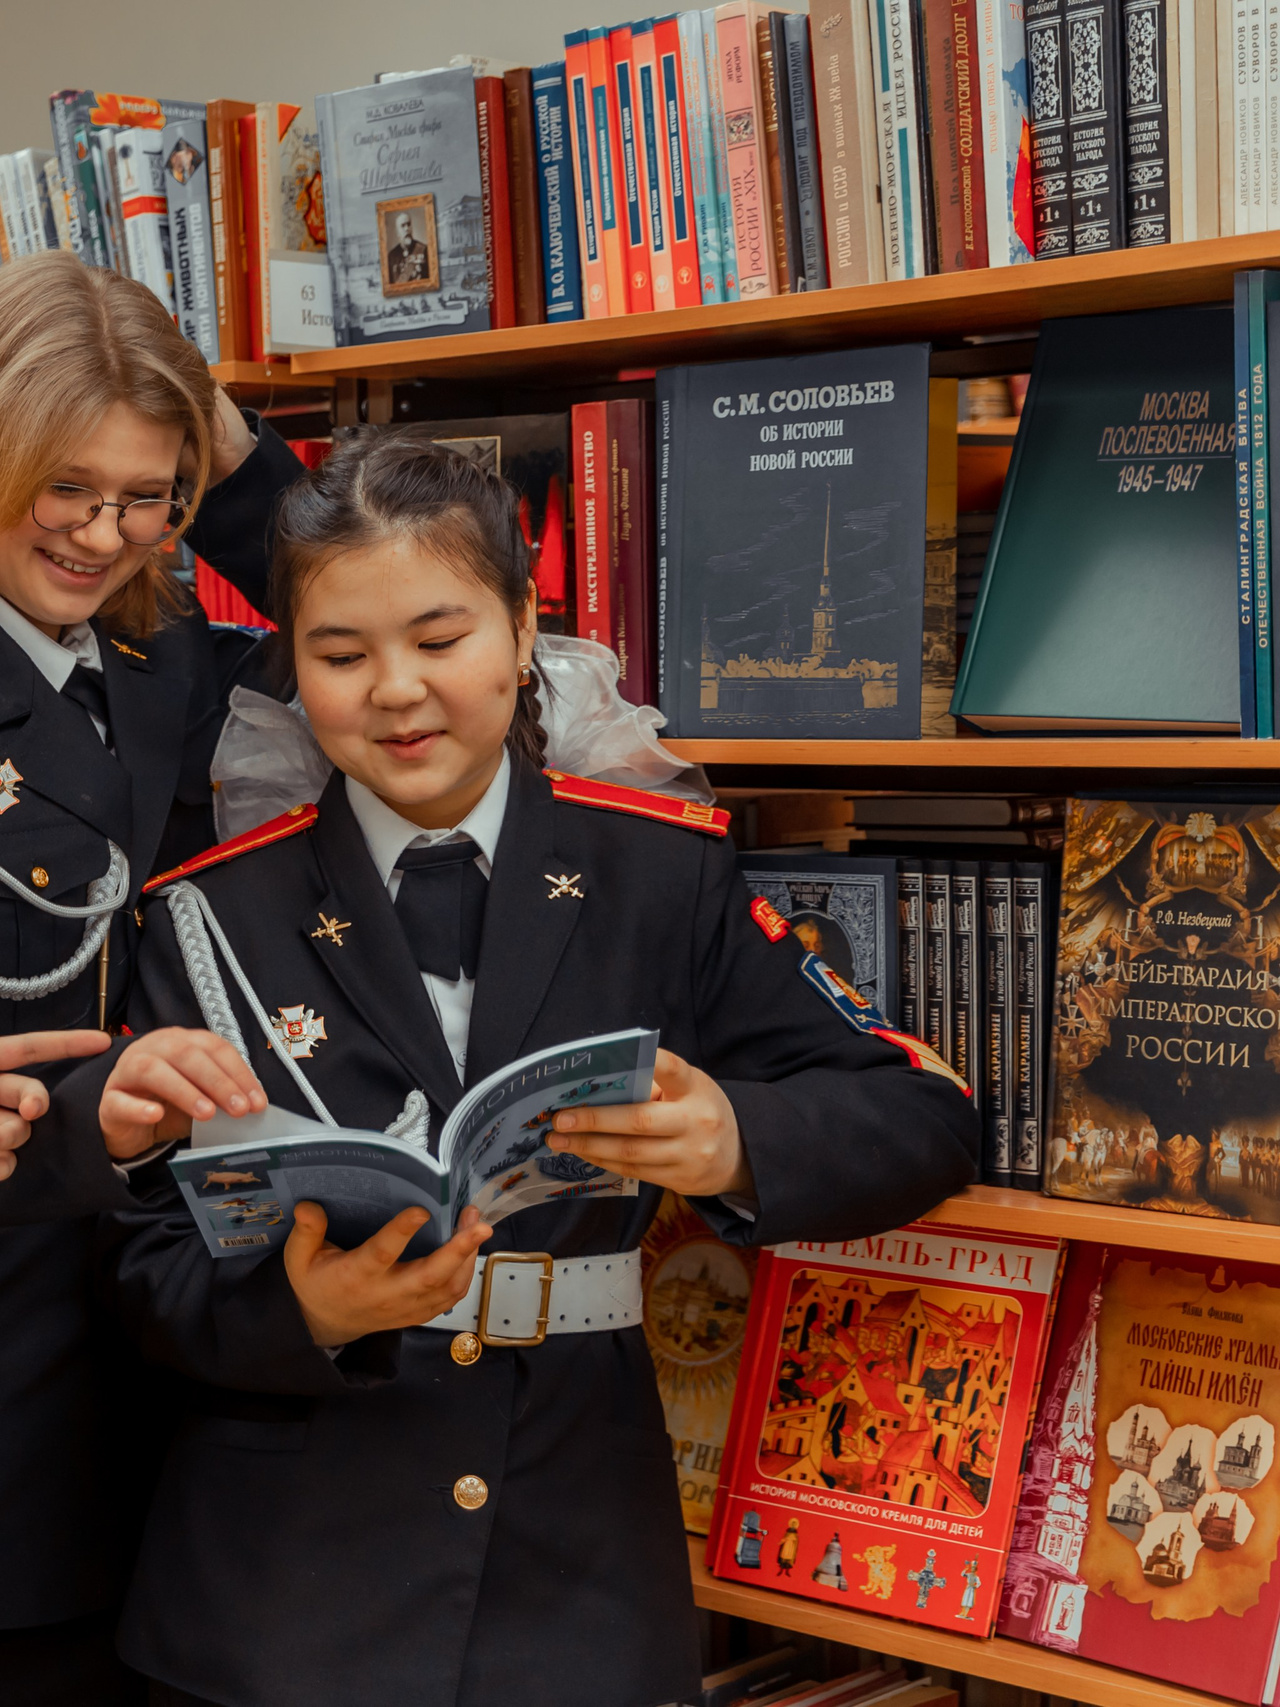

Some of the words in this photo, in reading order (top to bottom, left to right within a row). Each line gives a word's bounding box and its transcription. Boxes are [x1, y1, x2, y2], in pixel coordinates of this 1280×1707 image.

[953, 13, 968, 56] ДОЛГ
[986, 47, 994, 56] И
[1251, 23, 1260, 83] СУВОРОВ
[1269, 22, 1278, 82] СУВОРОВ
[725, 50, 734, 82] ЭПОХА
[732, 46, 744, 84] РЕФОРМ
[827, 53, 840, 83] века
[942, 34, 956, 111] Мономаха
[1238, 25, 1247, 85] СУВОРОВ
[789, 40, 805, 120] ПСЕВДОНИМОМ
[894, 67, 907, 120] ИДЕЯ
[987, 62, 996, 105] ПОБЕДА
[535, 94, 550, 151] РУССКОЙ
[622, 107, 632, 140] история
[668, 100, 677, 134] история
[832, 103, 844, 147] войнах
[955, 59, 972, 157] СОЛДАТСКИЙ
[1129, 120, 1159, 134] ИСТОРИЯ
[1239, 98, 1247, 145] НОВИКОВ
[1270, 95, 1278, 143] НОВИКОВ
[549, 105, 564, 160] ИСТОРИИ
[795, 127, 808, 148] ПОД
[989, 110, 998, 153] ТОЛЬКО
[1033, 134, 1061, 149] ИСТОРИЯ
[1072, 138, 1106, 152] РУССКОГО
[1073, 127, 1104, 141] ИСТОРИЯ
[1129, 131, 1160, 145] РУССКОГО
[1130, 142, 1157, 155] НАРОДА
[478, 101, 491, 213] ОСВОБОЖДЕНИЯ
[670, 136, 682, 197] Отечественная
[1033, 145, 1063, 160] РУССКОГО
[1035, 156, 1061, 169] НАРОДА
[1075, 149, 1103, 162] НАРОДА
[625, 142, 637, 202] Отечественная
[832, 164, 848, 199] СССР
[882, 101, 900, 267] ВОЕННО-МОРСКАЯ
[1240, 149, 1249, 207] АЛЕКСАНДР
[1253, 148, 1261, 206] АЛЕКСАНДР
[1270, 147, 1279, 205] АЛЕКСАНДР
[543, 164, 564, 268] КЛЮЧЕВСКИЙ
[584, 199, 593, 225] России
[651, 189, 659, 215] России
[732, 176, 748, 250] ИСТОРИЯ
[1086, 200, 1095, 217] 1
[1139, 194, 1148, 211] 1
[585, 226, 596, 255] История
[653, 216, 661, 246] История
[746, 206, 762, 271] РОССИИ
[174, 207, 195, 312] ЖИВОТНЫХ
[189, 203, 209, 310] КОНТИНЕНТОВ
[483, 215, 495, 302] ФИЛОСОФИЯ
[551, 269, 565, 282] О.
[301, 284, 315, 301] 63
[552, 284, 565, 299] В.
[302, 309, 333, 327] Исто
[712, 396, 736, 419] С.
[738, 392, 766, 416] М.
[768, 380, 895, 414] СОЛОВЬЕВ
[1252, 363, 1264, 405] ГОДА
[662, 399, 670, 440] РОССИИ
[1138, 390, 1210, 421] МОСКВА
[1237, 387, 1249, 447] БИТВА
[760, 425, 778, 443] ОБ
[782, 419, 844, 441] ИСТОРИИ
[1098, 422, 1236, 455] ПОСЛЕВОЕННАЯ
[1253, 413, 1263, 448] 1812
[583, 430, 596, 493] ДЕТСТВО
[661, 443, 669, 479] НОВОЙ
[749, 449, 796, 472] НОВОЙ
[801, 448, 854, 469] РОССИИ
[1253, 457, 1265, 510] ВОЙНА
[660, 483, 668, 530] ИСТОРИИ
[585, 497, 598, 613] РАССТРЕЛЯННОЕ
[1238, 461, 1250, 625] СТАЛИНГРАДСКАЯ
[1255, 518, 1269, 649] ОТЕЧЕСТВЕННАЯ
[658, 556, 667, 651] СОЛОВЬЕВ
[1178, 911, 1232, 930] Незвецкий
[907, 933, 916, 962] России
[933, 936, 942, 965] России
[961, 938, 970, 967] России
[995, 941, 1004, 969] России
[1025, 941, 1034, 970] России
[907, 963, 916, 987] новой
[933, 965, 942, 989] новой
[960, 968, 969, 992] новой
[995, 970, 1004, 994] новой
[1025, 971, 1034, 995] новой
[1120, 959, 1269, 991] ЛЕЙБ-ГВАРДИЯ
[930, 1007, 940, 1051] АМЗИН
[1090, 996, 1280, 1030] ИМПЕРАТОРСКО
[957, 1010, 967, 1078] КАРАМЗИН
[991, 1013, 1001, 1081] КАРАМЗИН
[1020, 1014, 1031, 1083] КАРАМЗИН
[1125, 1034, 1250, 1068] РОССИИ
[1126, 1321, 1224, 1359] МОСКОВСКИЕ
[1140, 1358, 1205, 1398] ТАЙНЫ
[1206, 1371, 1264, 1408] ИМЁН
[750, 1482, 797, 1501] ИСТОРИЯ
[798, 1492, 880, 1518] МОСКОВСКОГО
[880, 1507, 924, 1527] КРЕМЛЯ
[924, 1517, 948, 1532] ДЛЯ
[948, 1521, 984, 1539] ДЕТЕЙ
